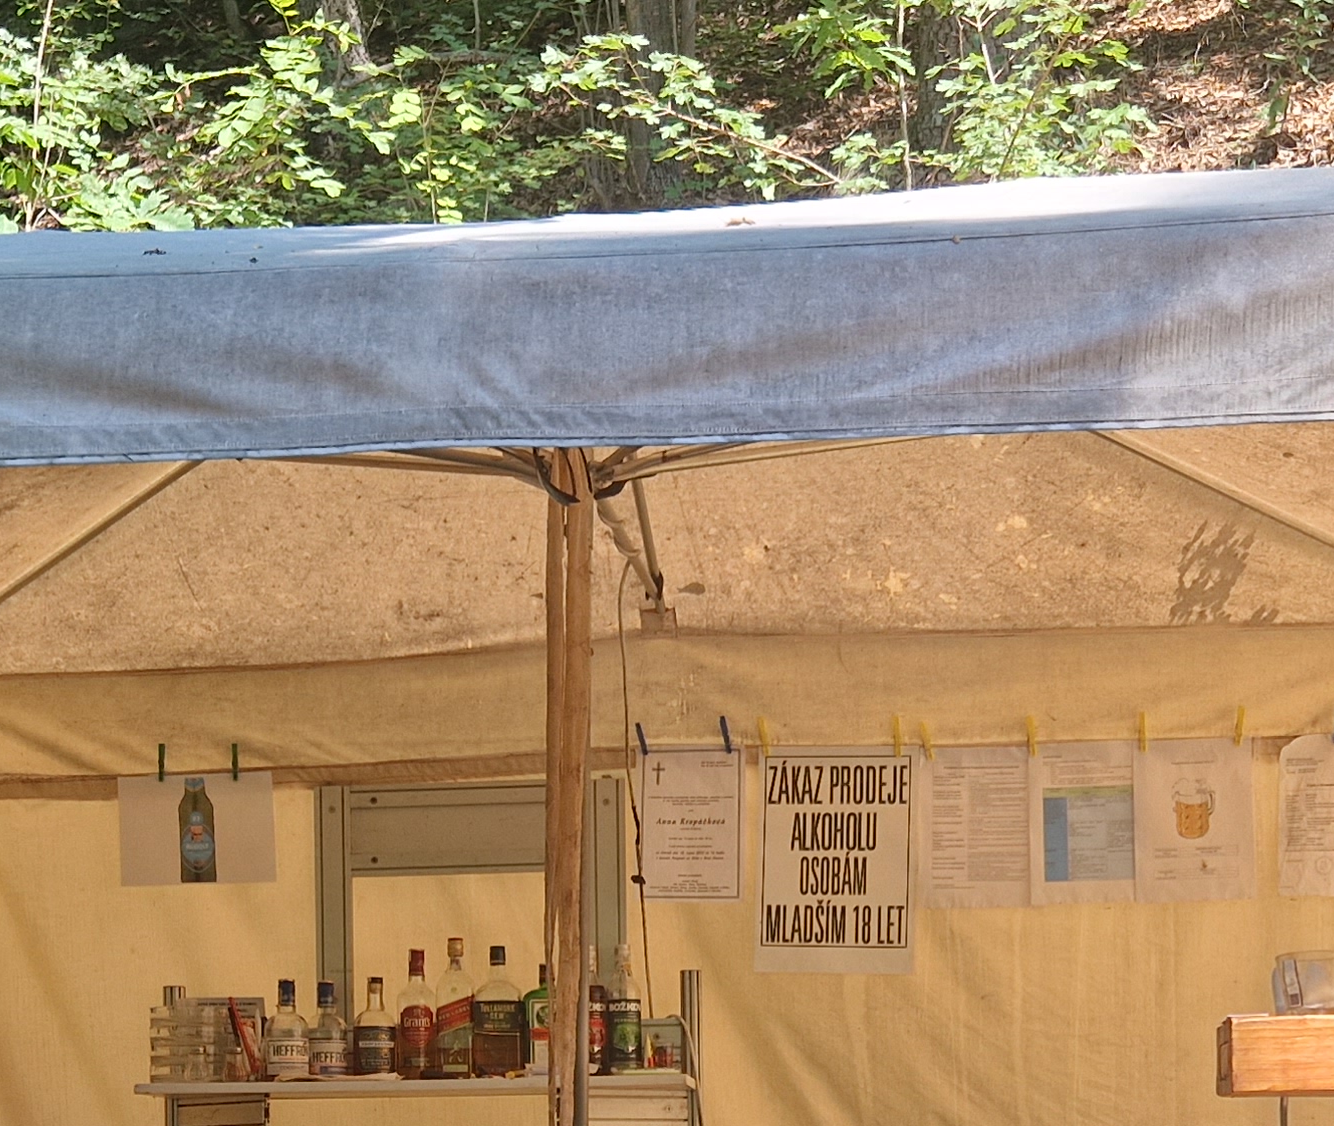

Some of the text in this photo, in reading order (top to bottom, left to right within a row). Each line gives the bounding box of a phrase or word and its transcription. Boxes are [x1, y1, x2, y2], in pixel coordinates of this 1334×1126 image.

[768, 760, 908, 805] ZÁKAZ PRODEJE
[791, 812, 877, 851] ALKOHOLU
[800, 852, 867, 895] OSOBÁM
[766, 900, 905, 945] MLADŠÍM 18 LET
